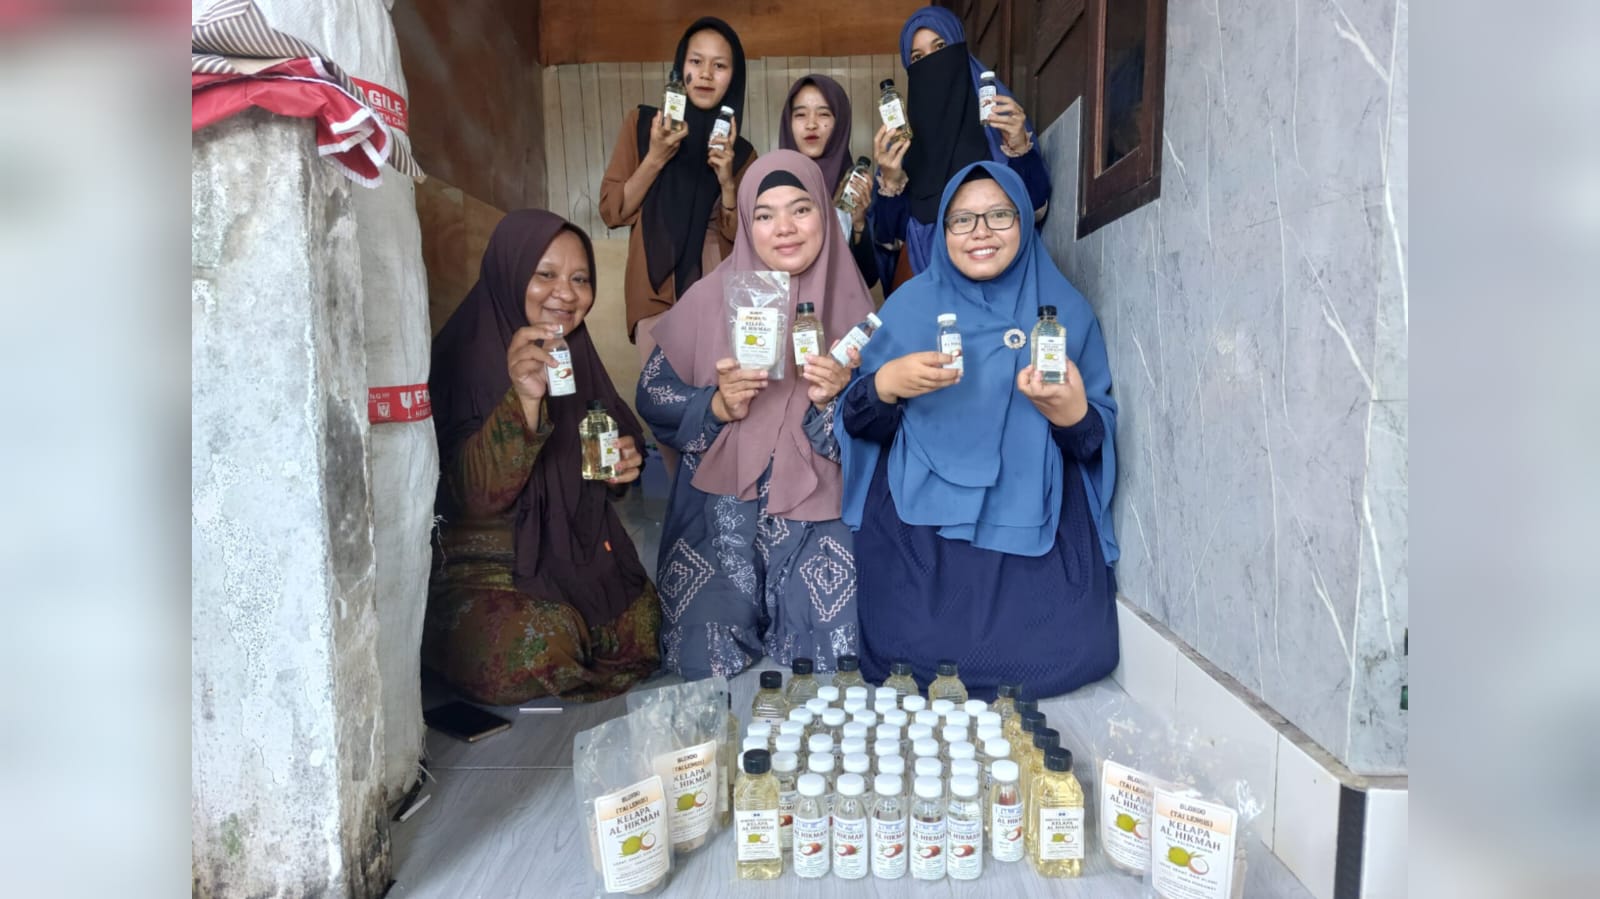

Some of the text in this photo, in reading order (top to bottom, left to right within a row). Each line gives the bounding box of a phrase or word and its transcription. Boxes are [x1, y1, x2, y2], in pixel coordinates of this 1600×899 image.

[368, 89, 403, 118] GILE
[673, 768, 706, 783] KELAPA
[679, 771, 712, 788] HIKMAH
[1110, 794, 1121, 804] AL
[609, 826, 622, 836] AL
[624, 811, 661, 832] HIKMAH
[616, 805, 651, 825] KELAPA
[883, 832, 905, 841] HIKMA
[1160, 825, 1174, 836] AL
[1175, 831, 1221, 851] HIKMAH
[1168, 819, 1211, 839] KELAPA
